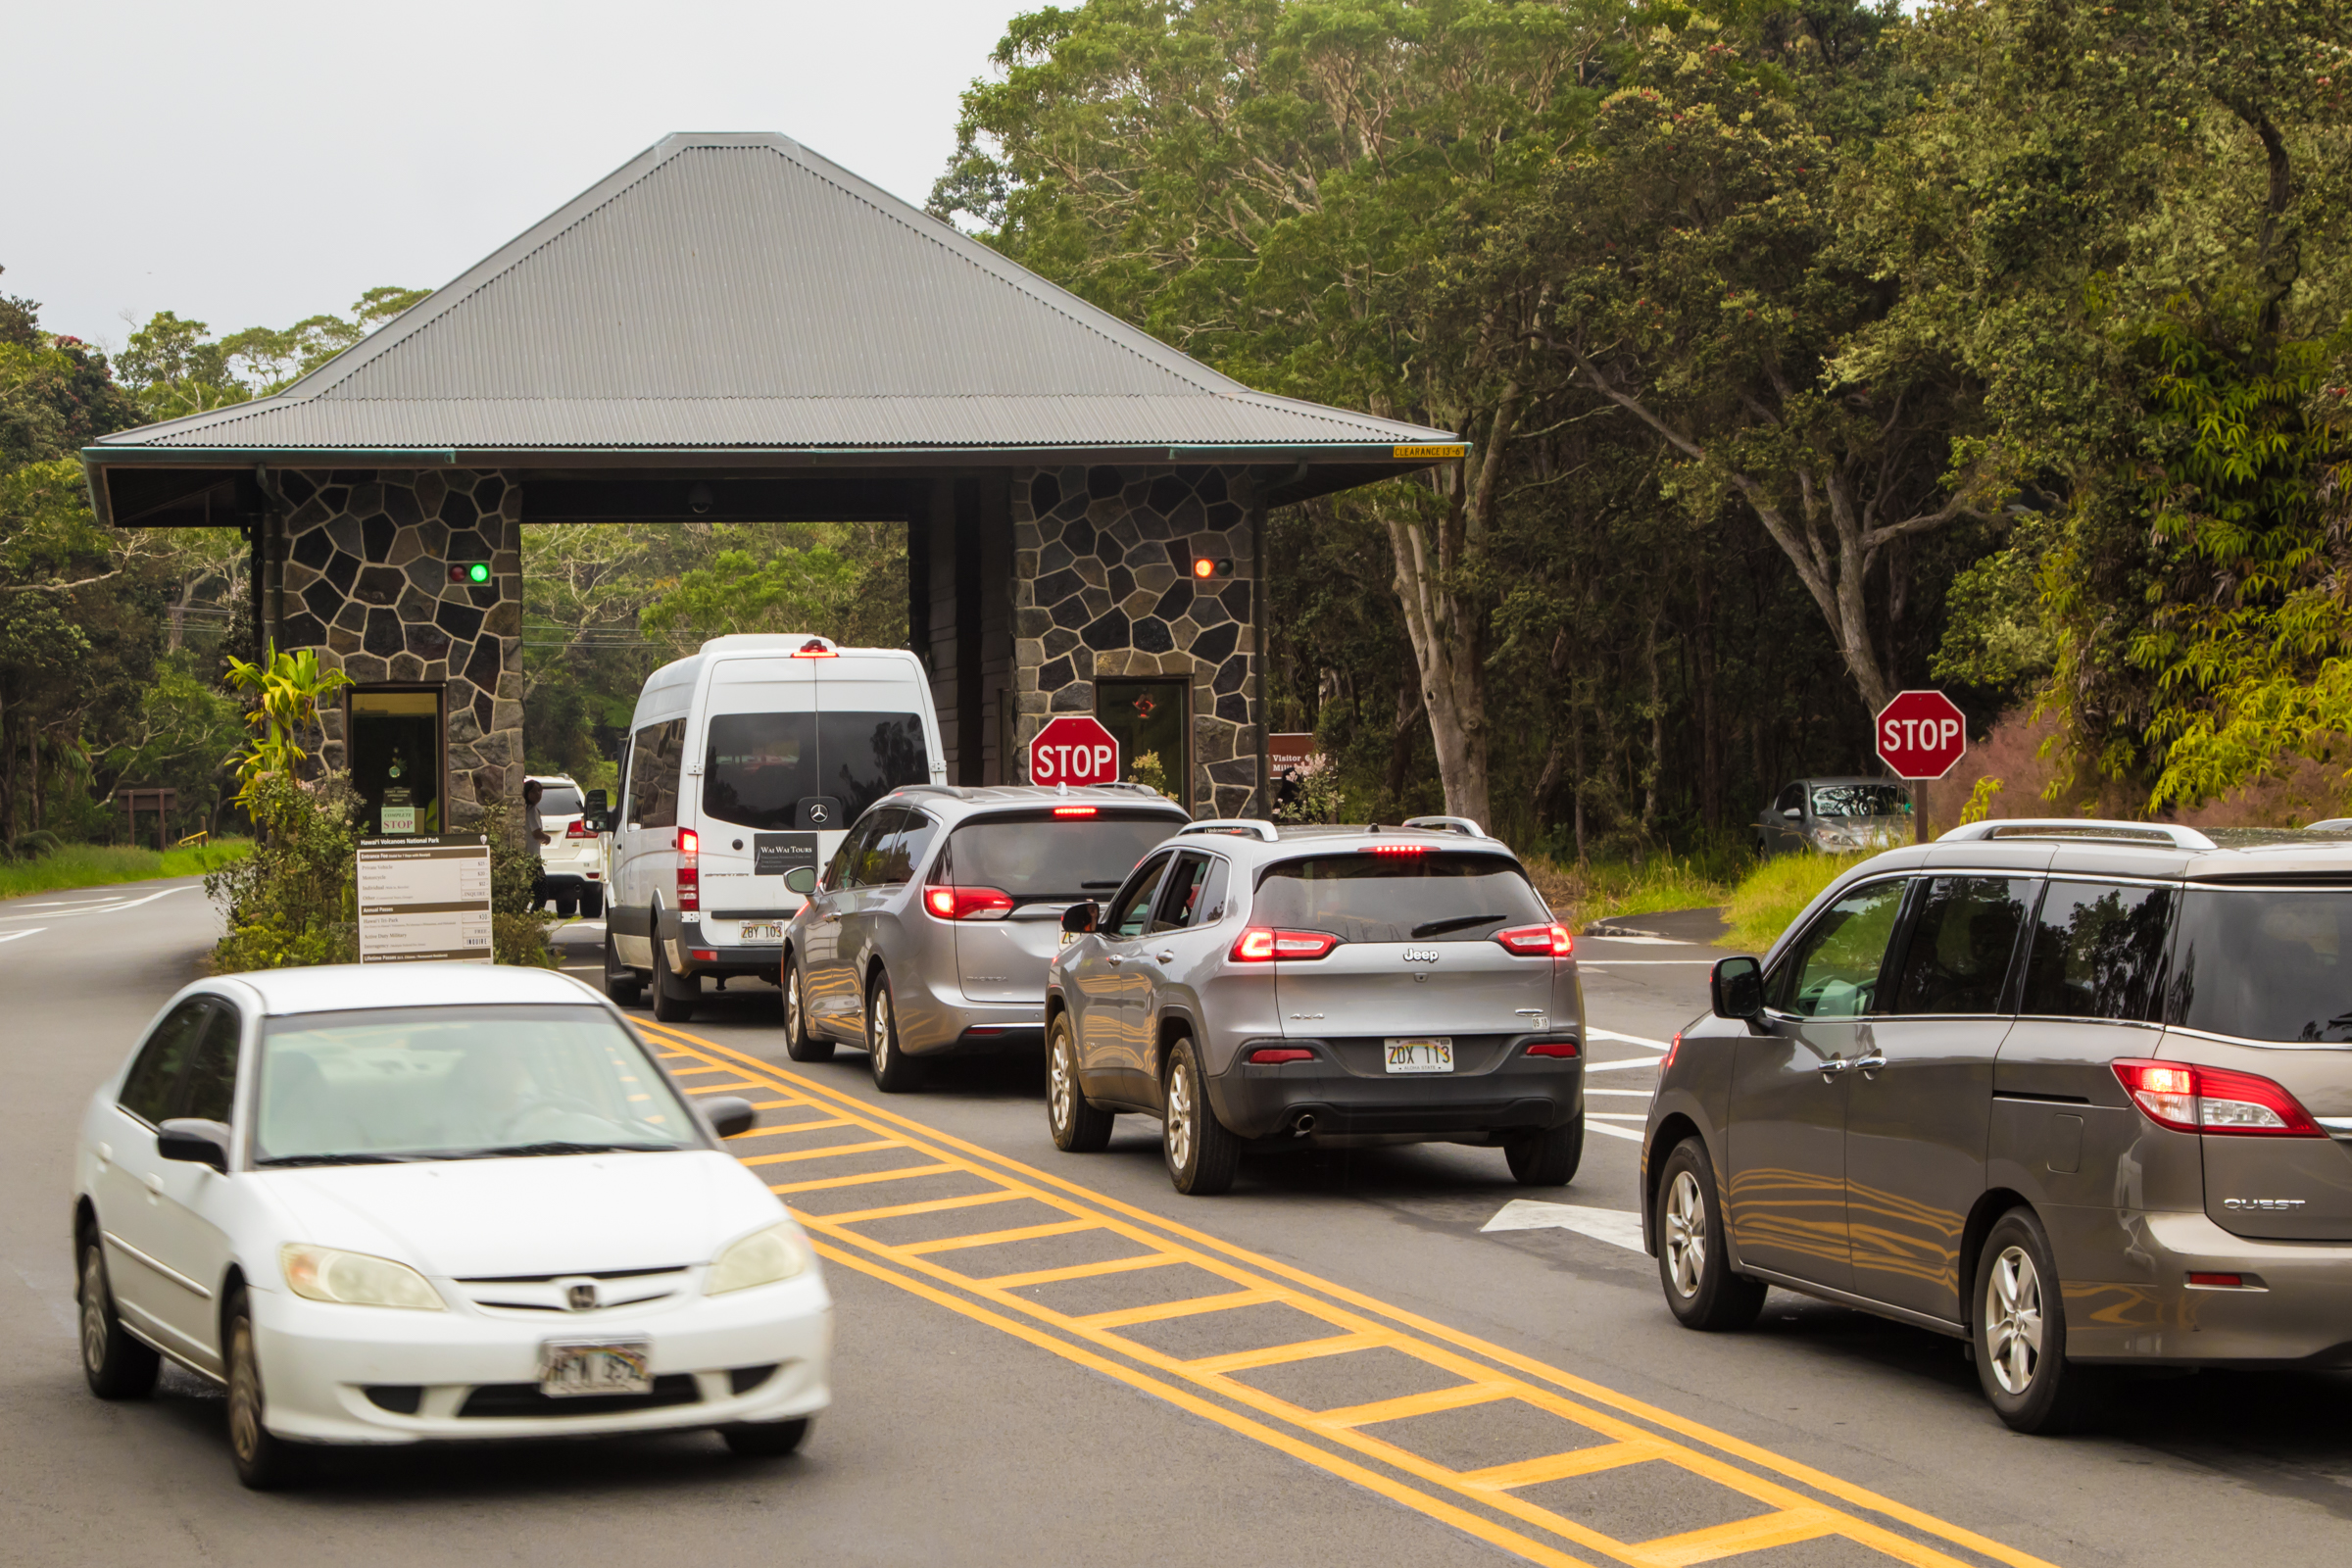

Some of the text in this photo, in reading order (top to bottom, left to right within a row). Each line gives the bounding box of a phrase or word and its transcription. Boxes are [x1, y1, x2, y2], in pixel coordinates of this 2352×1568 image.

[1395, 447, 1440, 456] CLEARANCE
[1884, 719, 1959, 751] STOP
[1037, 745, 1112, 777] STOP
[384, 820, 413, 829] STOP
[742, 926, 782, 938] ZBY 103
[1403, 948, 1439, 963] Jeep
[1388, 1046, 1450, 1064] ZDX 113
[2224, 1198, 2305, 1212] QUEST
